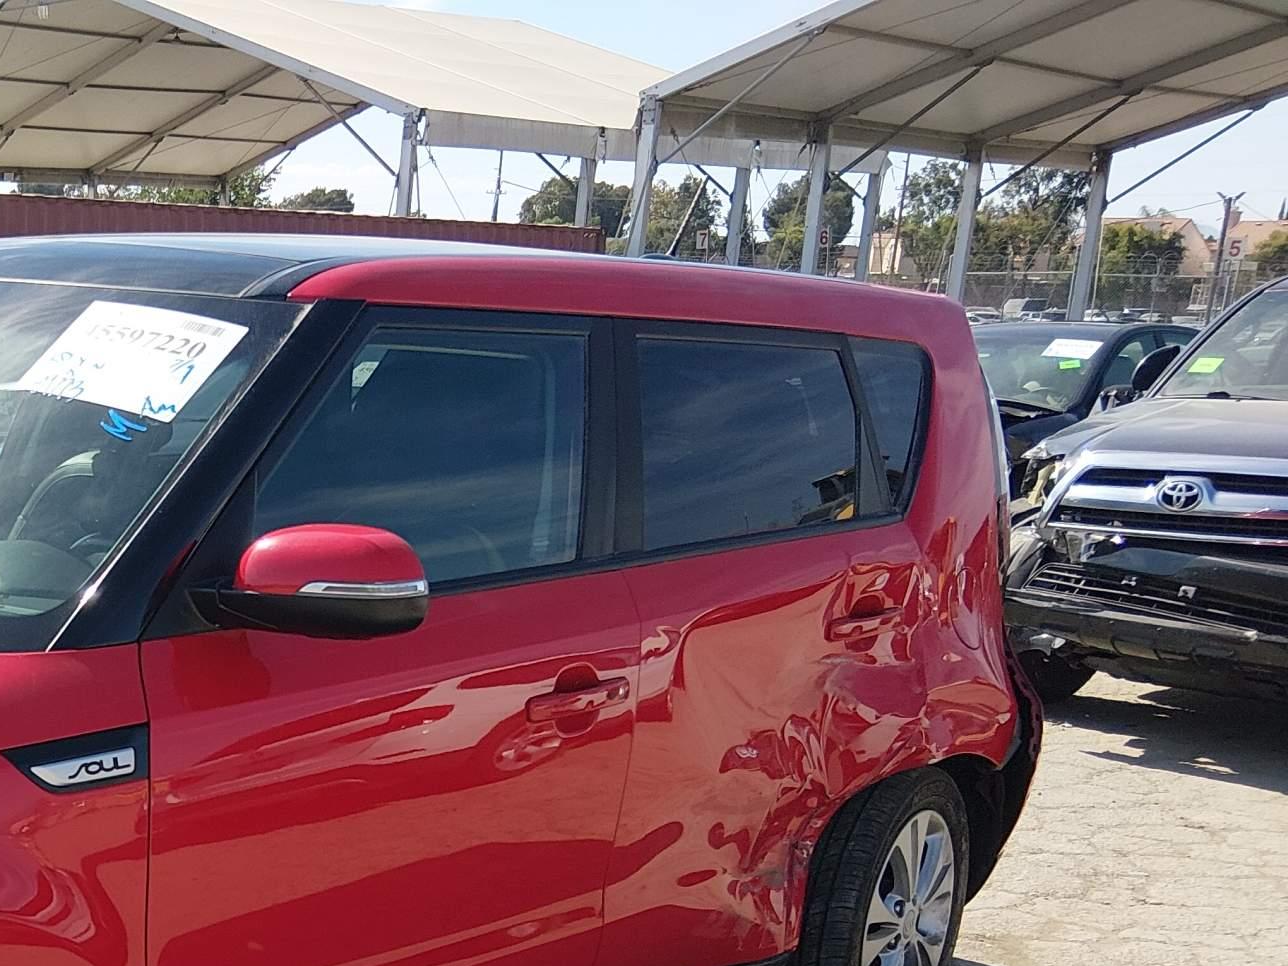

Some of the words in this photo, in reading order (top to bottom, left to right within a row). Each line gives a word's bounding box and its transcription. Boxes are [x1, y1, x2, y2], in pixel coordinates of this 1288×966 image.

[699, 232, 707, 247] 7
[819, 229, 829, 246] 6
[1228, 239, 1243, 258] 5
[67, 756, 132, 780] SOUL
